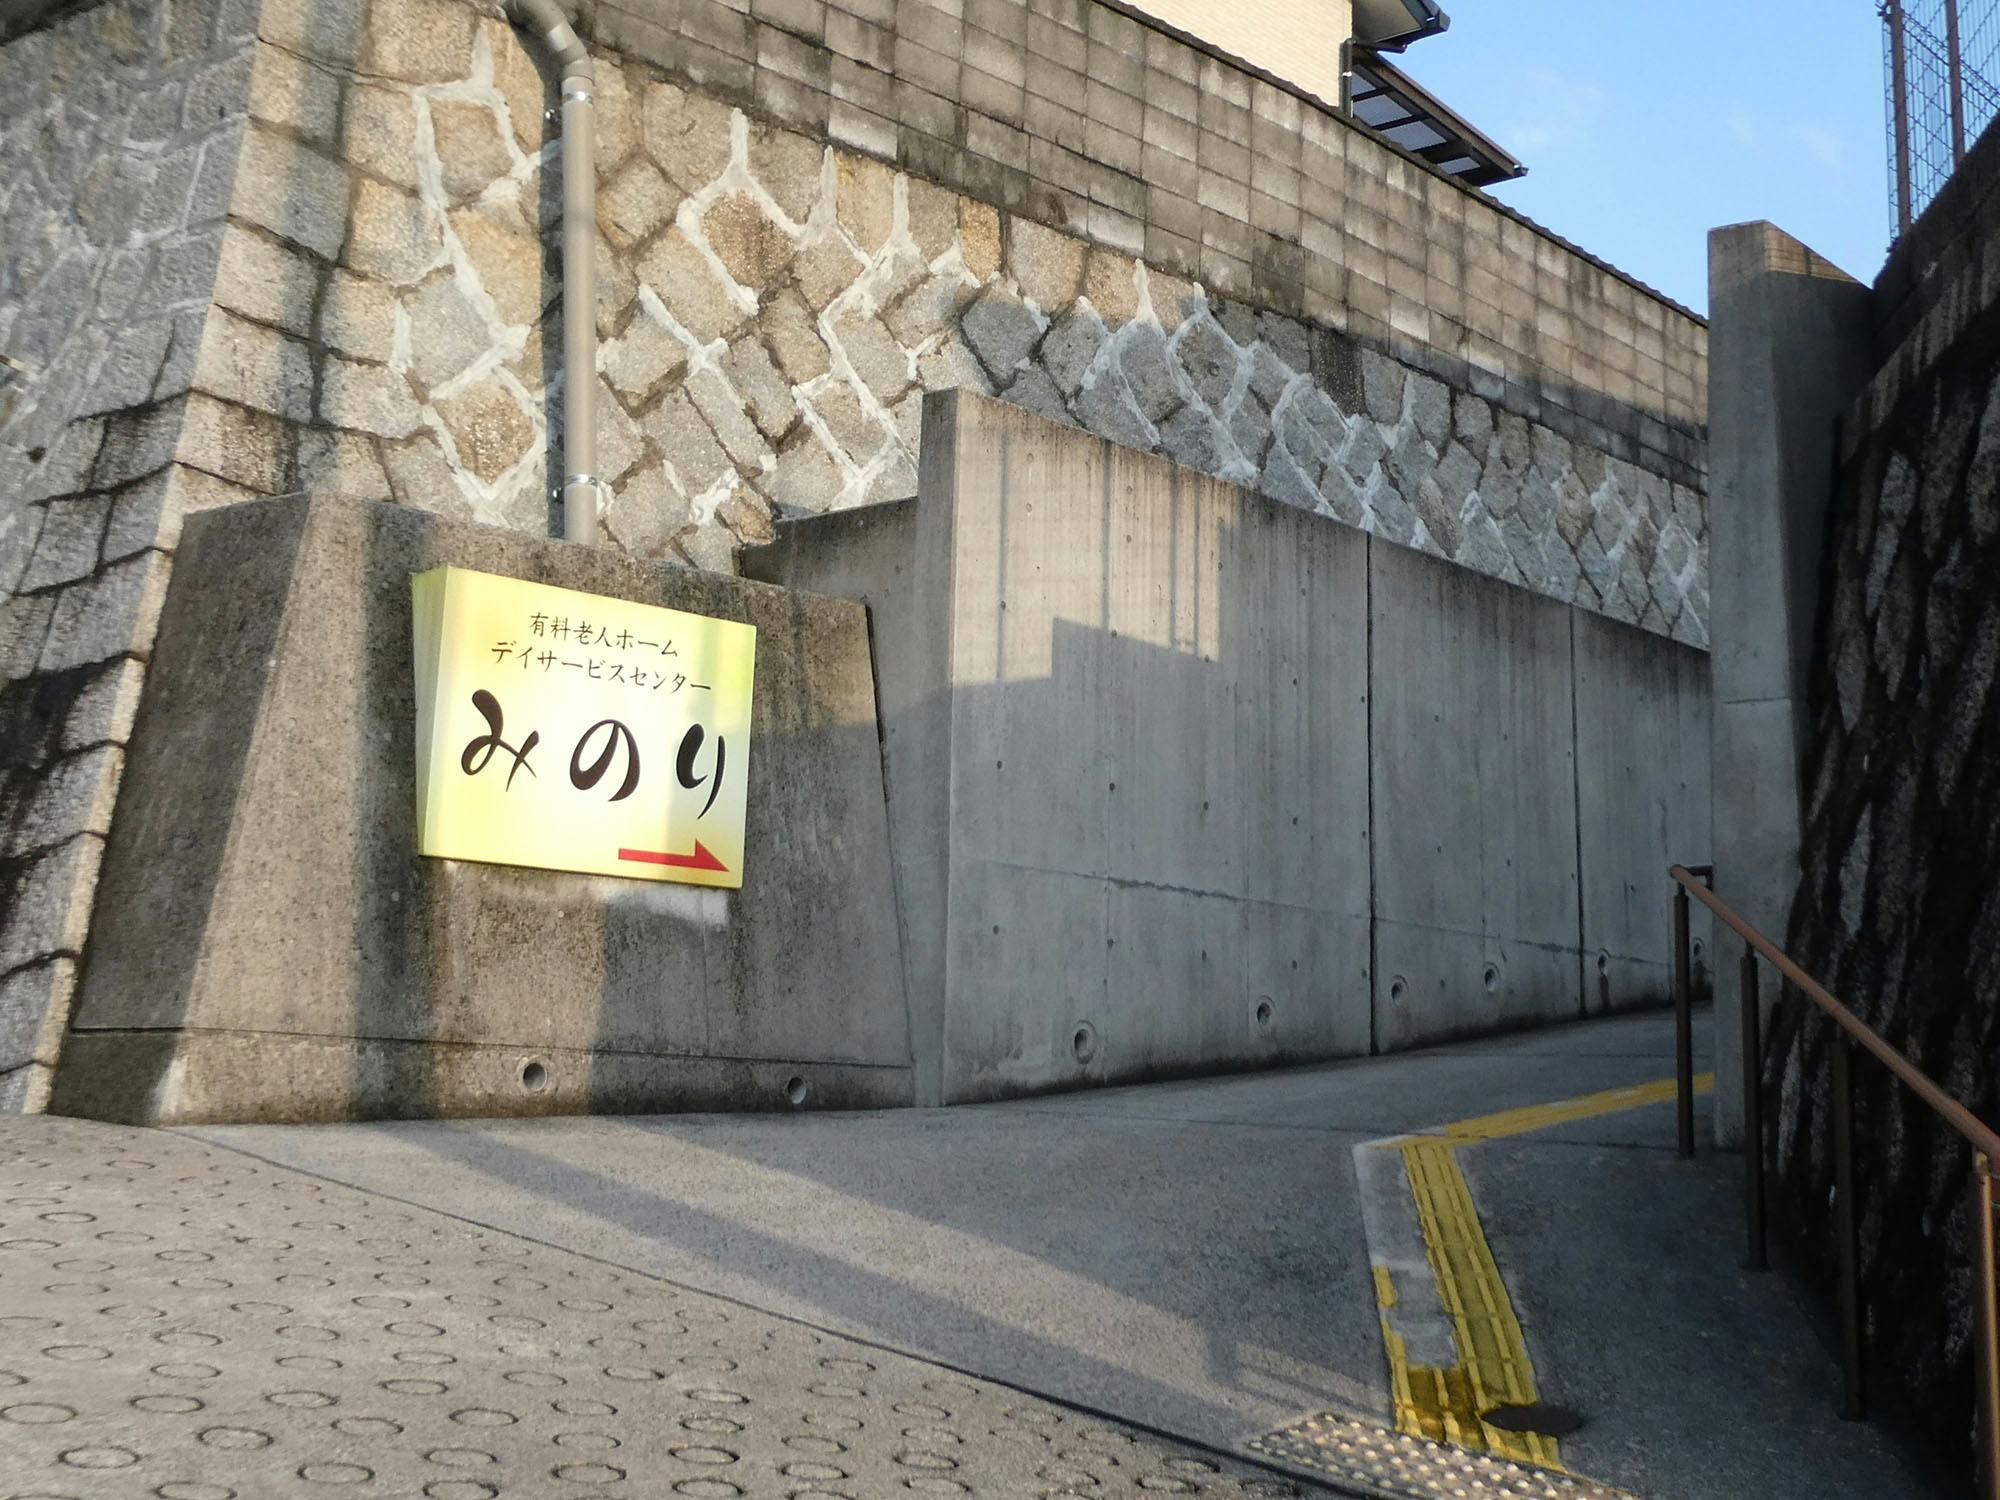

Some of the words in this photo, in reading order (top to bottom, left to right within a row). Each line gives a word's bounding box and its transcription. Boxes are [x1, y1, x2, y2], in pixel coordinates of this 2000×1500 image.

[530, 612, 678, 657] 有料老人ホーム
[491, 641, 711, 694] デイサービスセンター
[461, 689, 726, 820] みのり
